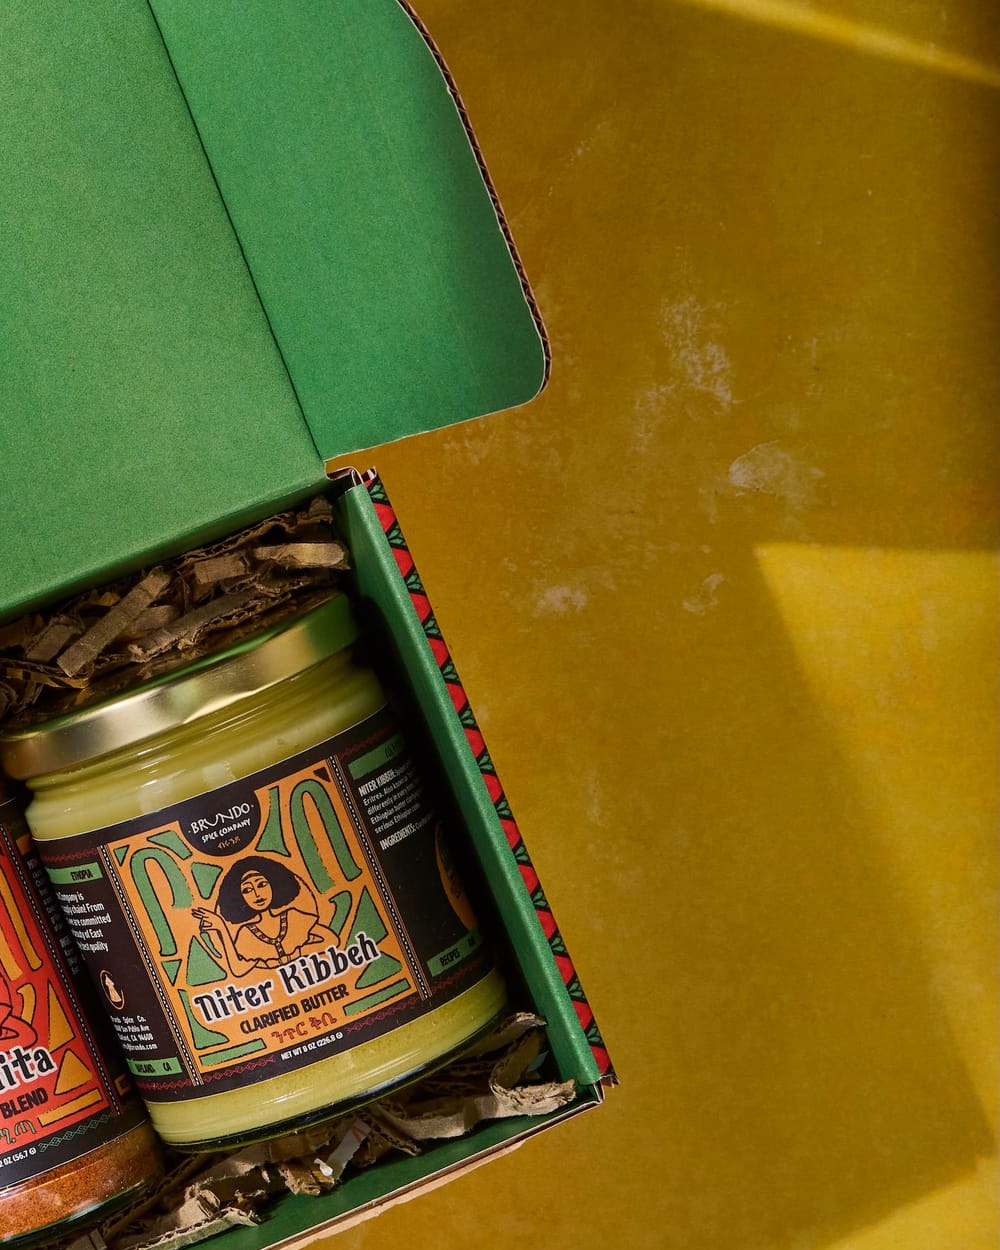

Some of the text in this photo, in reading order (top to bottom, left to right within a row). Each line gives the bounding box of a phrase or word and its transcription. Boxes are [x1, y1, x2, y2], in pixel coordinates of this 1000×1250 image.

[190, 802, 250, 834] BRUNDO
[201, 818, 251, 843] SPICE COMPANY
[86, 902, 105, 913] From
[89, 928, 104, 939] East
[194, 932, 380, 1022] Niter Kibbeh
[240, 982, 350, 1035] CLARIFIED BUTTER
[281, 1051, 295, 1061] NET
[293, 1047, 305, 1057] WT
[307, 1042, 317, 1051] OZ
[0, 1087, 49, 1119] BLEND
[3, 1156, 13, 1166] OZ
